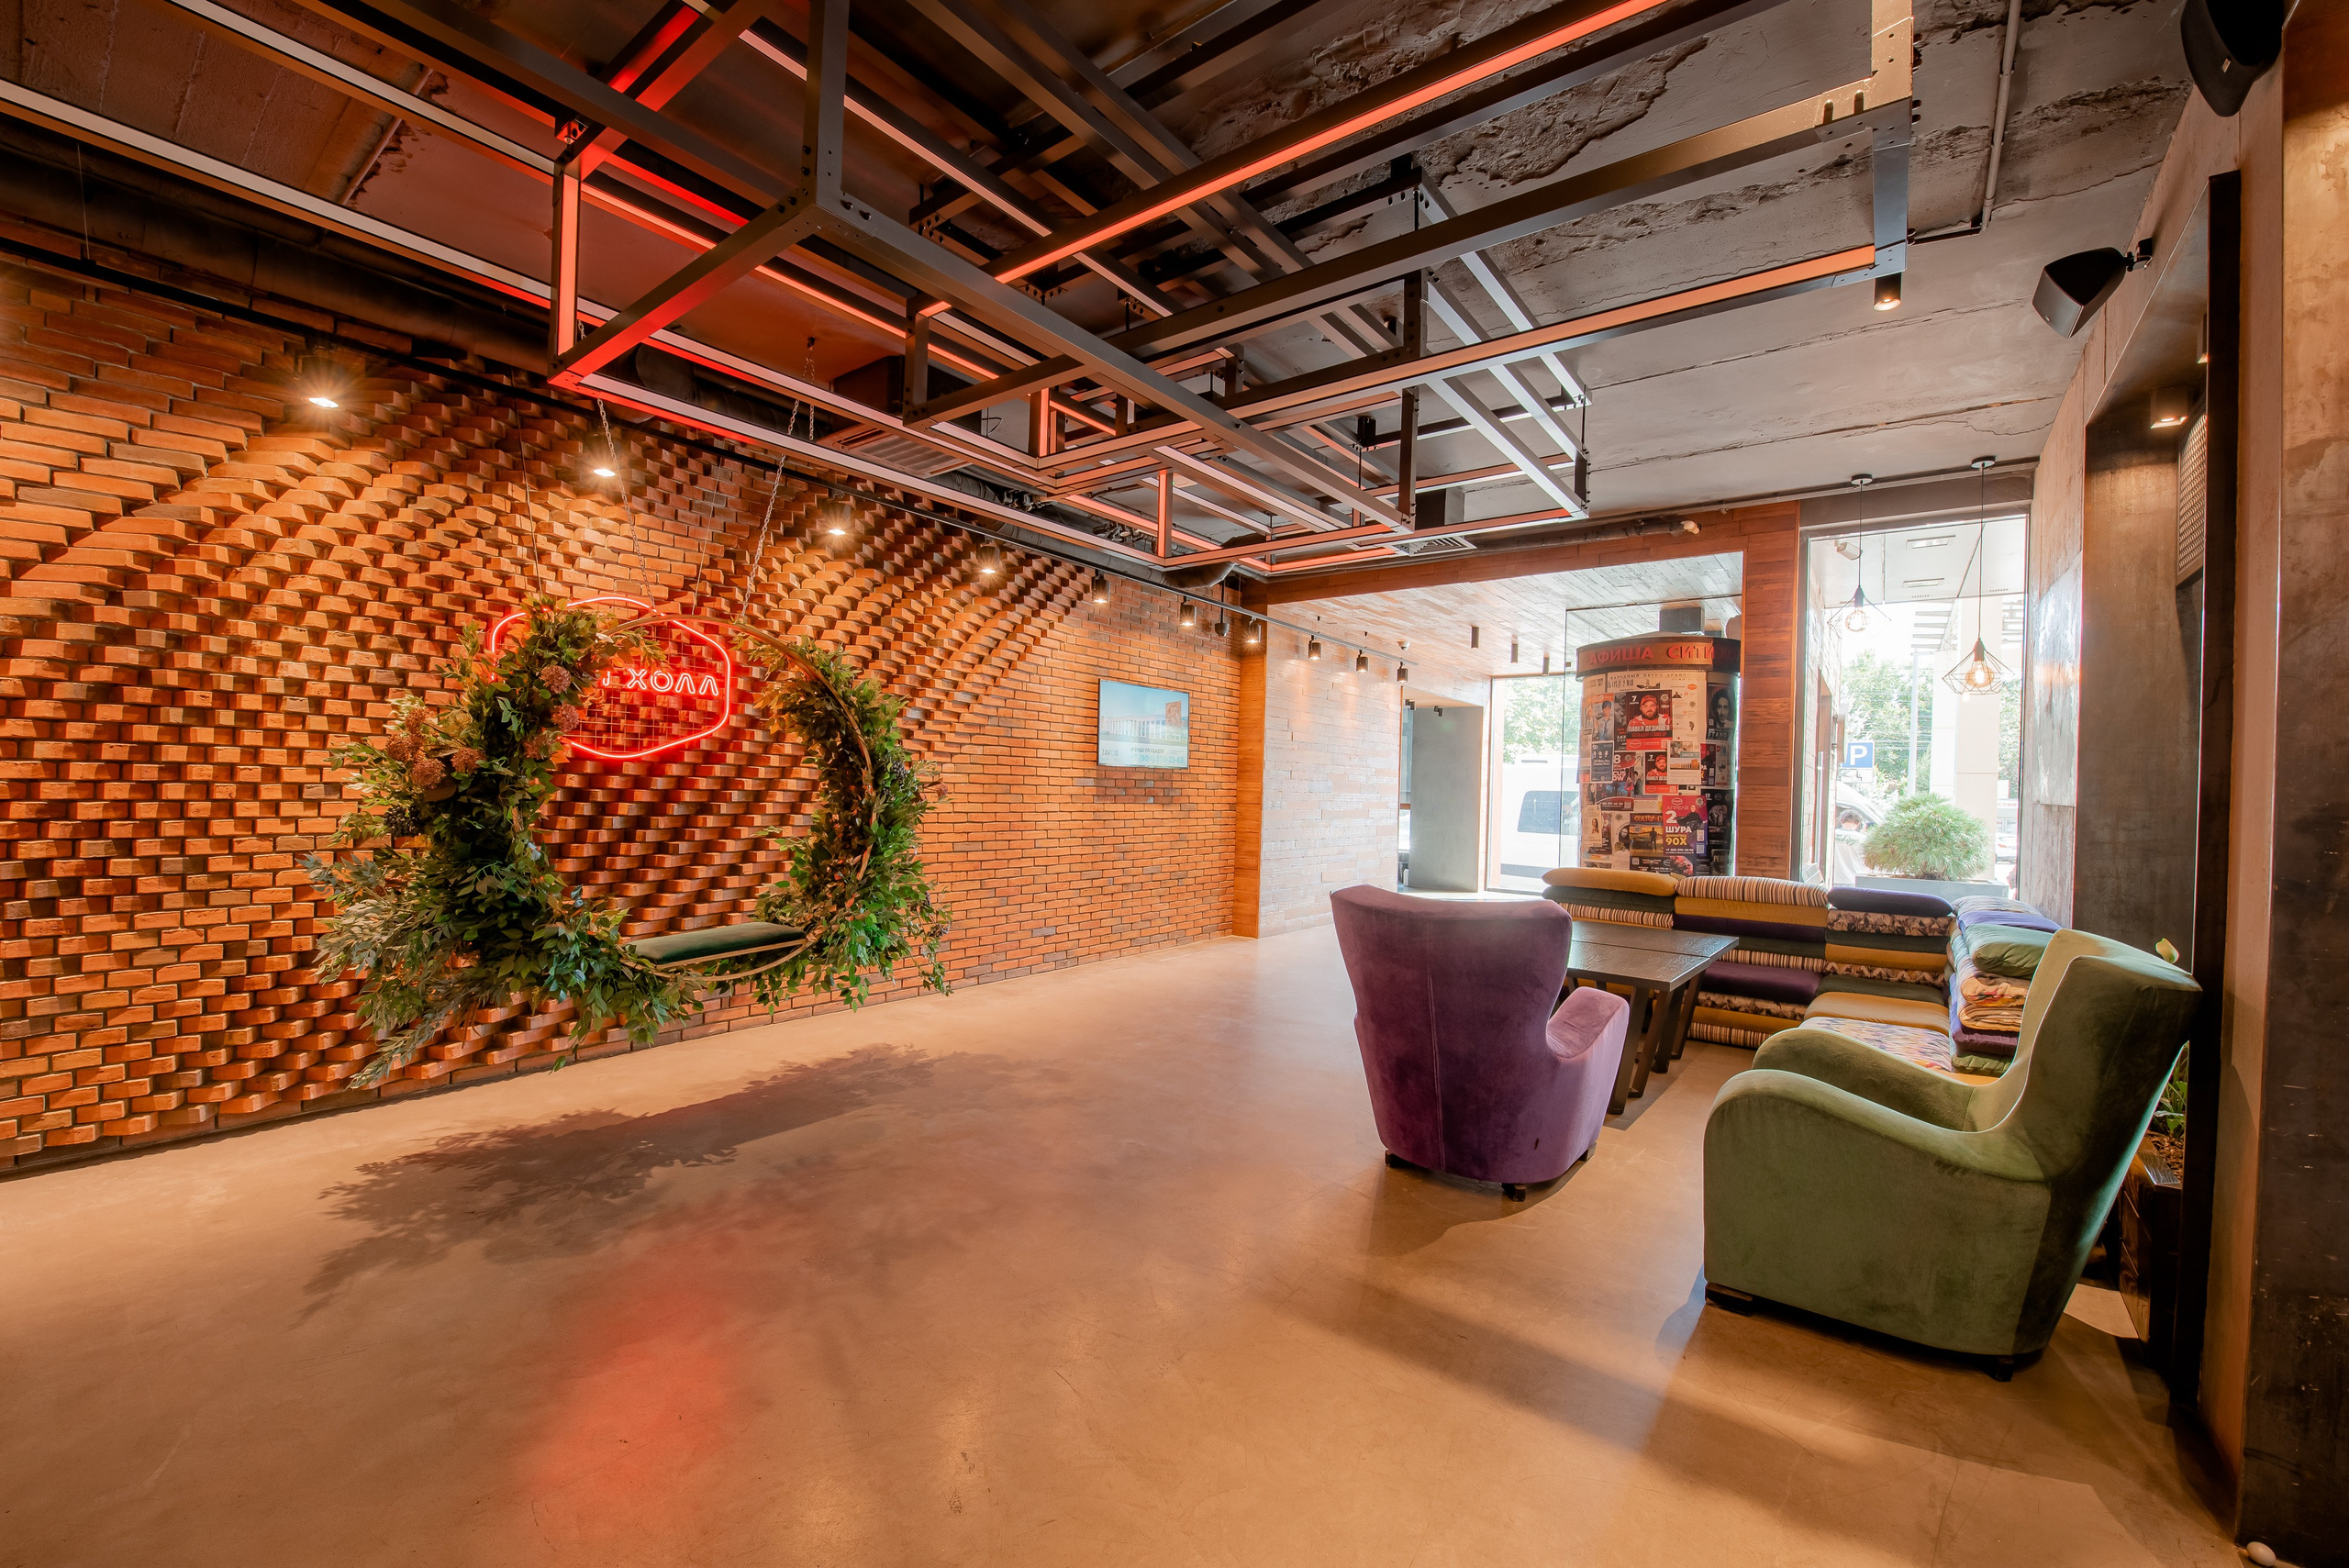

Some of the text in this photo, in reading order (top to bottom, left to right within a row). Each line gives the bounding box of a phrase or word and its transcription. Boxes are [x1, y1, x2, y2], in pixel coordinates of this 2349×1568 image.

[1589, 646, 1653, 665] АФИША
[1667, 645, 1715, 660] СИТИ
[1665, 810, 1677, 824] 2
[1665, 826, 1692, 834] ШУРА
[1665, 837, 1687, 846] 90Х
